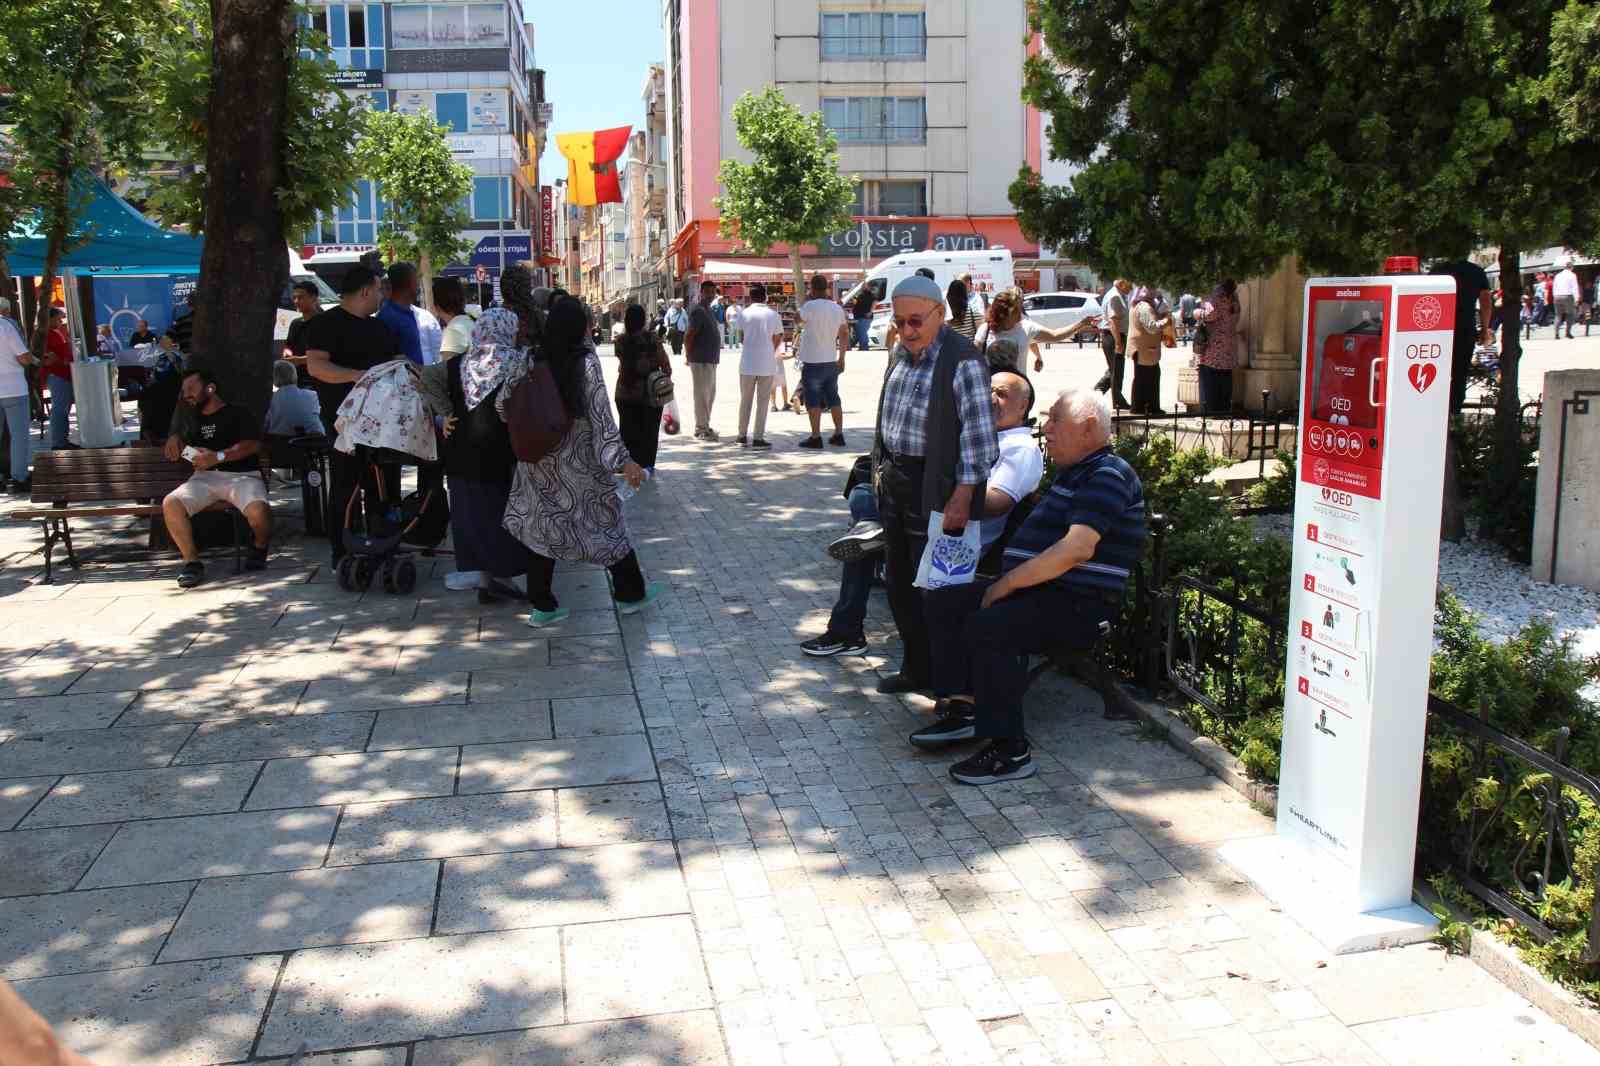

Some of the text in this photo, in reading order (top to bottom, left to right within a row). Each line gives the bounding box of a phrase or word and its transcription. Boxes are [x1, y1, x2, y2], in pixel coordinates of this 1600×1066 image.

[1406, 344, 1442, 359] OED
[1331, 397, 1351, 411] OED
[1332, 491, 1353, 506] OED
